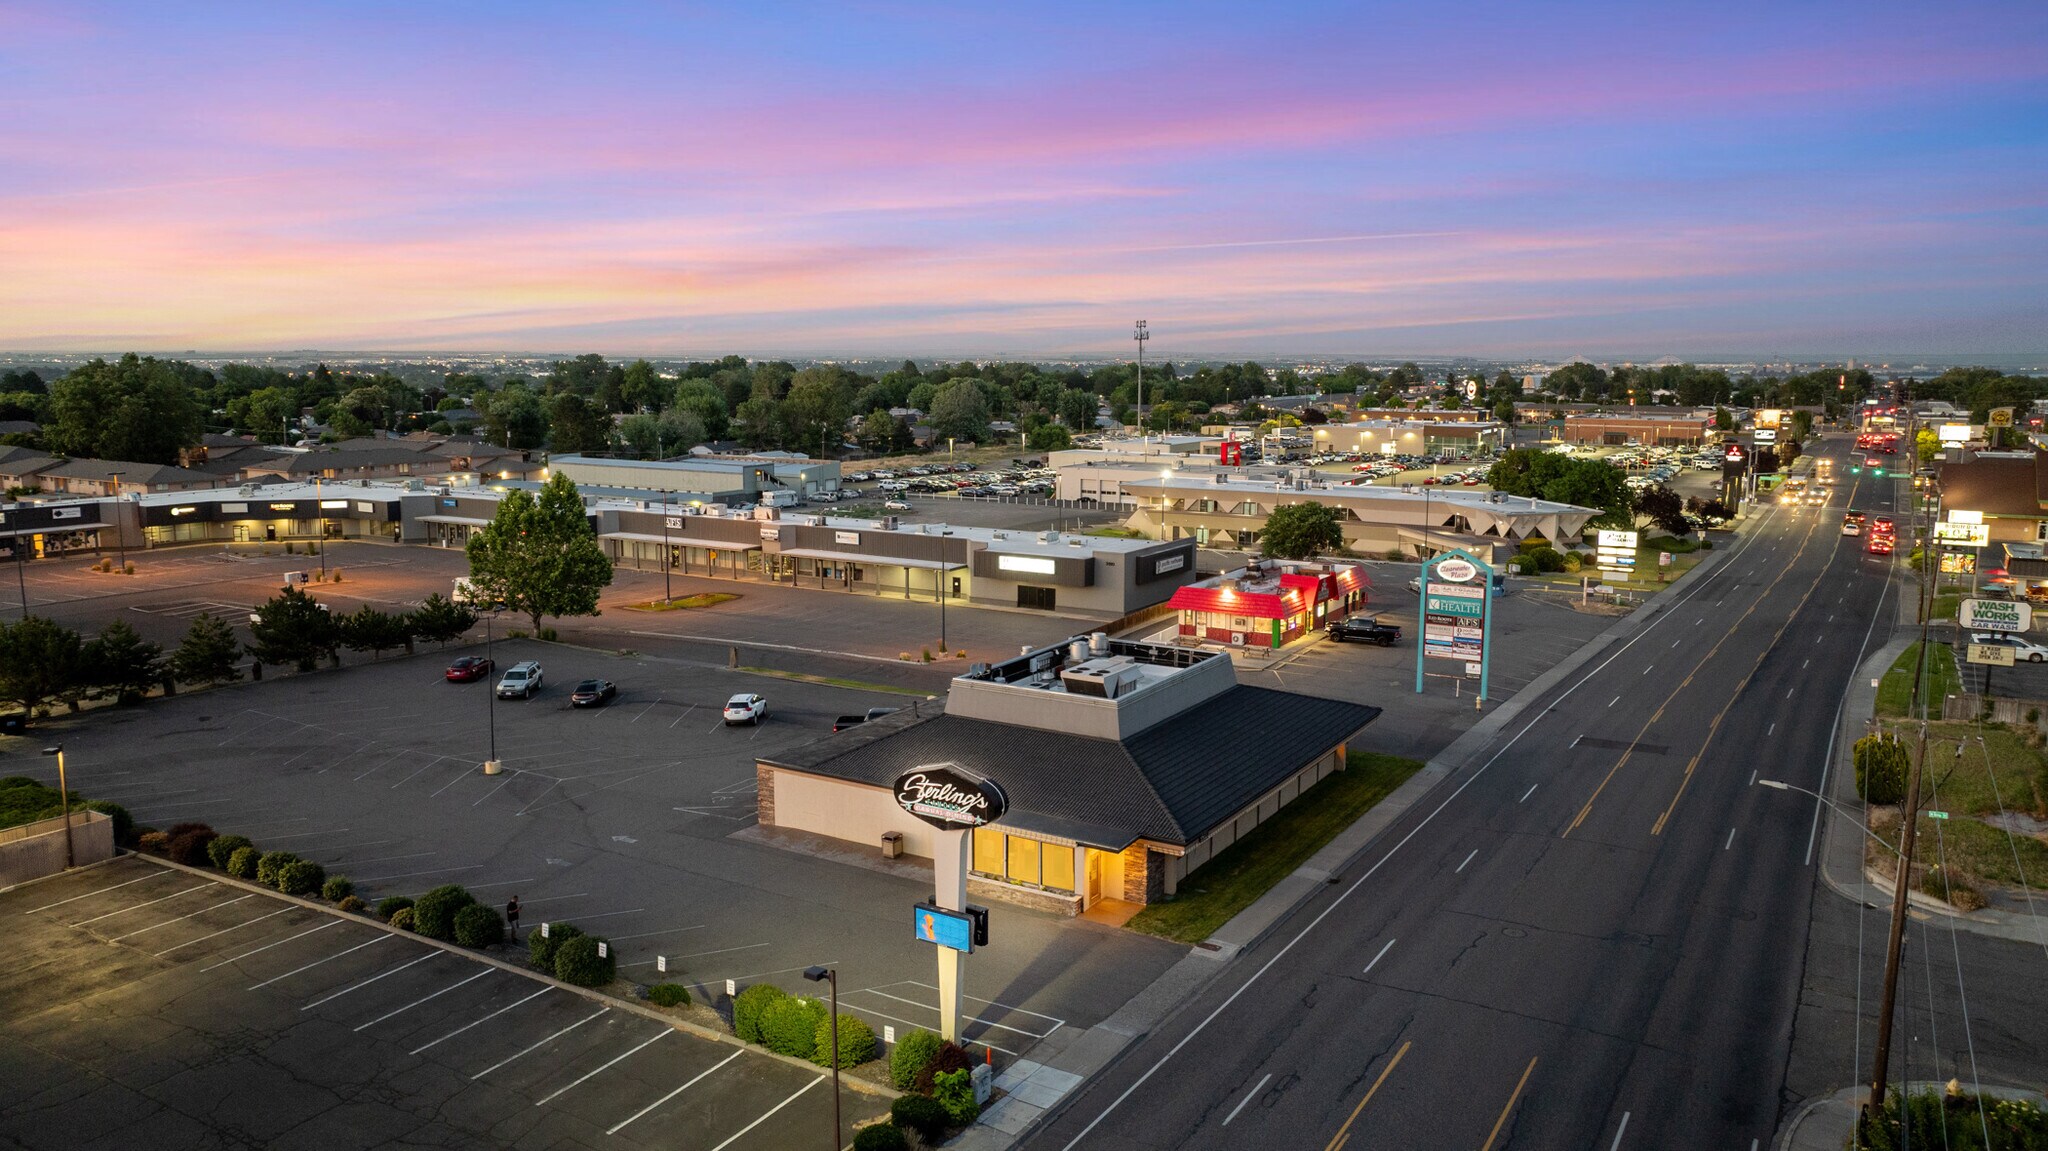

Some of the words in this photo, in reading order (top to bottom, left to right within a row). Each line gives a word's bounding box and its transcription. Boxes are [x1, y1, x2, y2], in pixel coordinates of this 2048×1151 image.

[1440, 565, 1470, 573] Clearwater
[1440, 603, 1480, 614] HEALTH
[1977, 601, 2015, 612] WASH
[1973, 610, 2020, 621] WORKS
[1458, 617, 1478, 626] AFS
[898, 773, 989, 814] Sterling's
[915, 805, 943, 816] CASUAL
[945, 811, 973, 822] DINING
